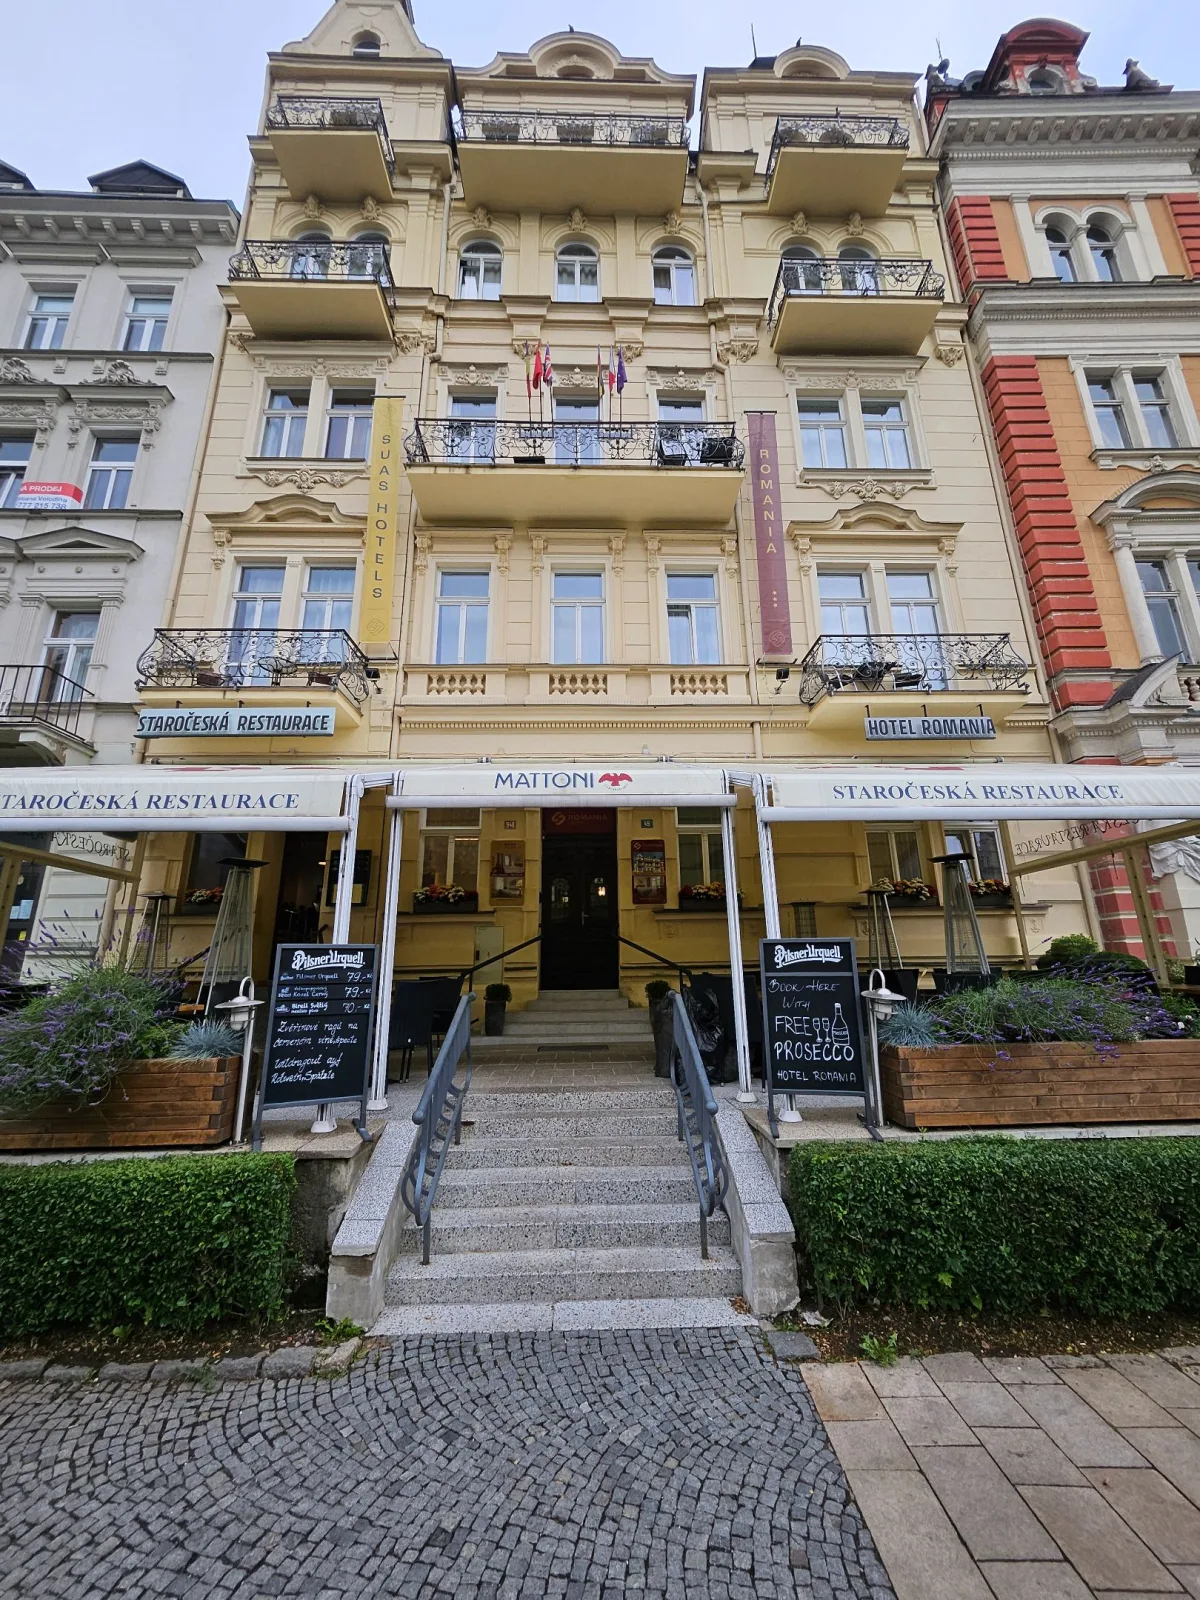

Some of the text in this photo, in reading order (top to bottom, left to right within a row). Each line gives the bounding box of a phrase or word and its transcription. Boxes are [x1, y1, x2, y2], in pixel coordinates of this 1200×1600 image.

[759, 449, 777, 554] ROMANIA
[372, 434, 392, 598] SUAS HOTELS
[137, 711, 330, 732] STAROČESKÁ RESTAURACE
[868, 718, 997, 736] HOTEL ROMANIA
[494, 771, 594, 789] MATTONI
[0, 790, 301, 810] TAROČESKÁ RESTAURACE
[832, 781, 1124, 800] STAROČESKÁ RESTAURACE
[567, 812, 608, 821] ROMANIA
[291, 949, 330, 971] Pilsner
[774, 944, 809, 969] Pilsner
[317, 973, 339, 981] Urquell
[347, 1022, 359, 1030] na
[775, 1015, 813, 1036] FREE
[774, 1040, 855, 1062] PROSECCO
[777, 1069, 857, 1083] HOTEL ROMANIA
